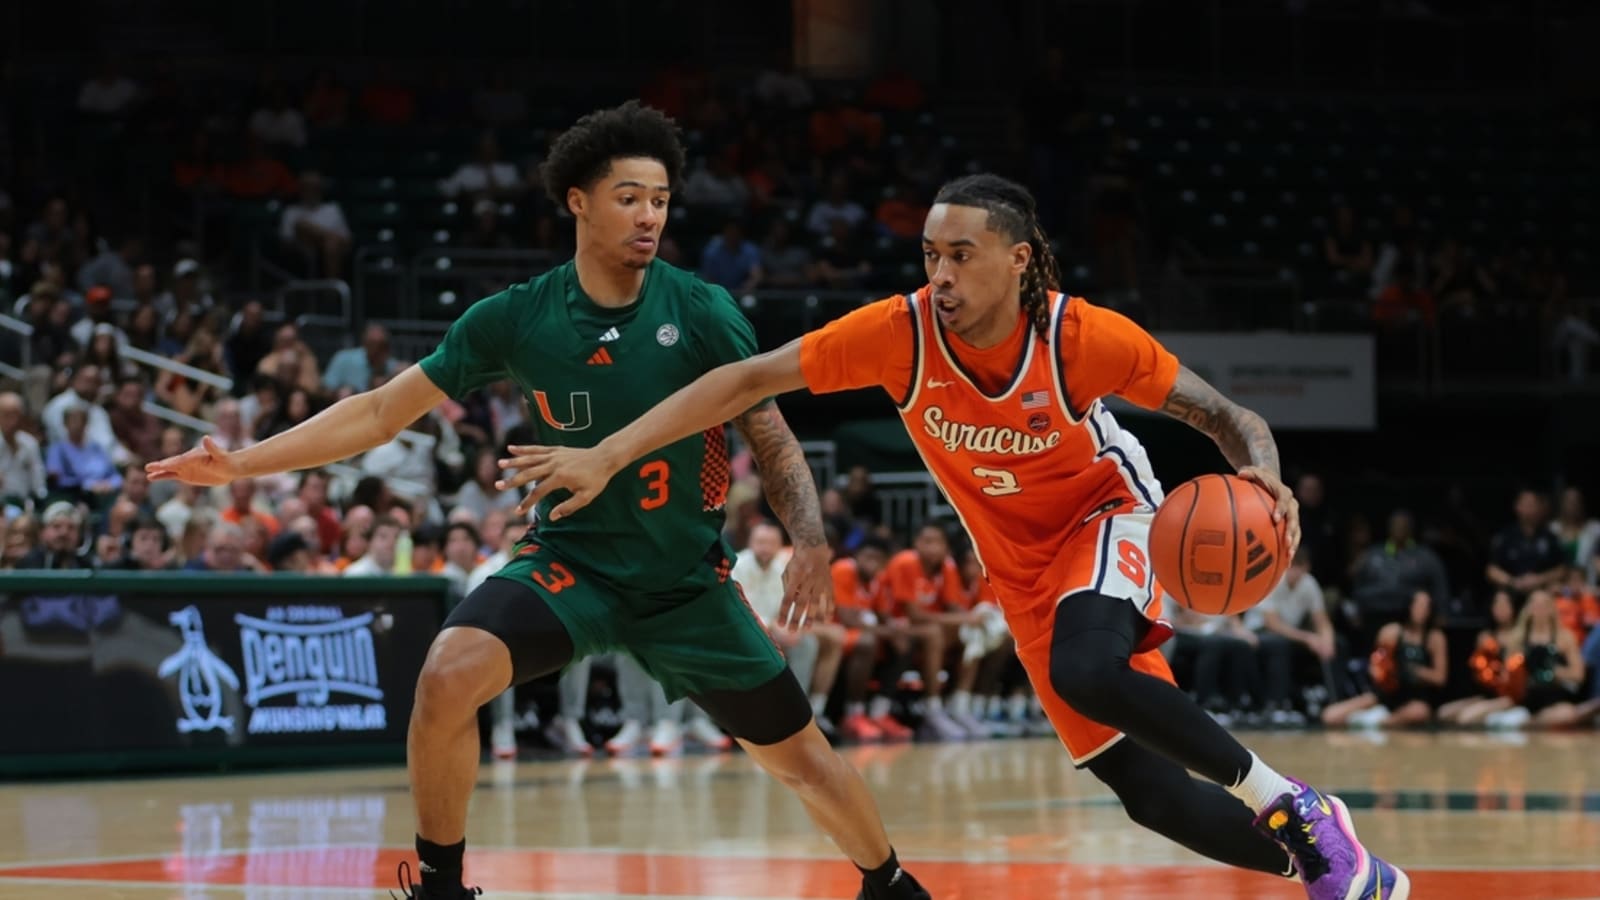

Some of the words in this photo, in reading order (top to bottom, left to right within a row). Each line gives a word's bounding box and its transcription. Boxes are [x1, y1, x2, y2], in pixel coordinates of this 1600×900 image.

[533, 390, 592, 431] U
[922, 405, 1061, 456] Syracuse
[639, 460, 671, 510] 3
[972, 465, 1022, 496] 3
[531, 561, 576, 594] 3
[1116, 538, 1147, 589] S
